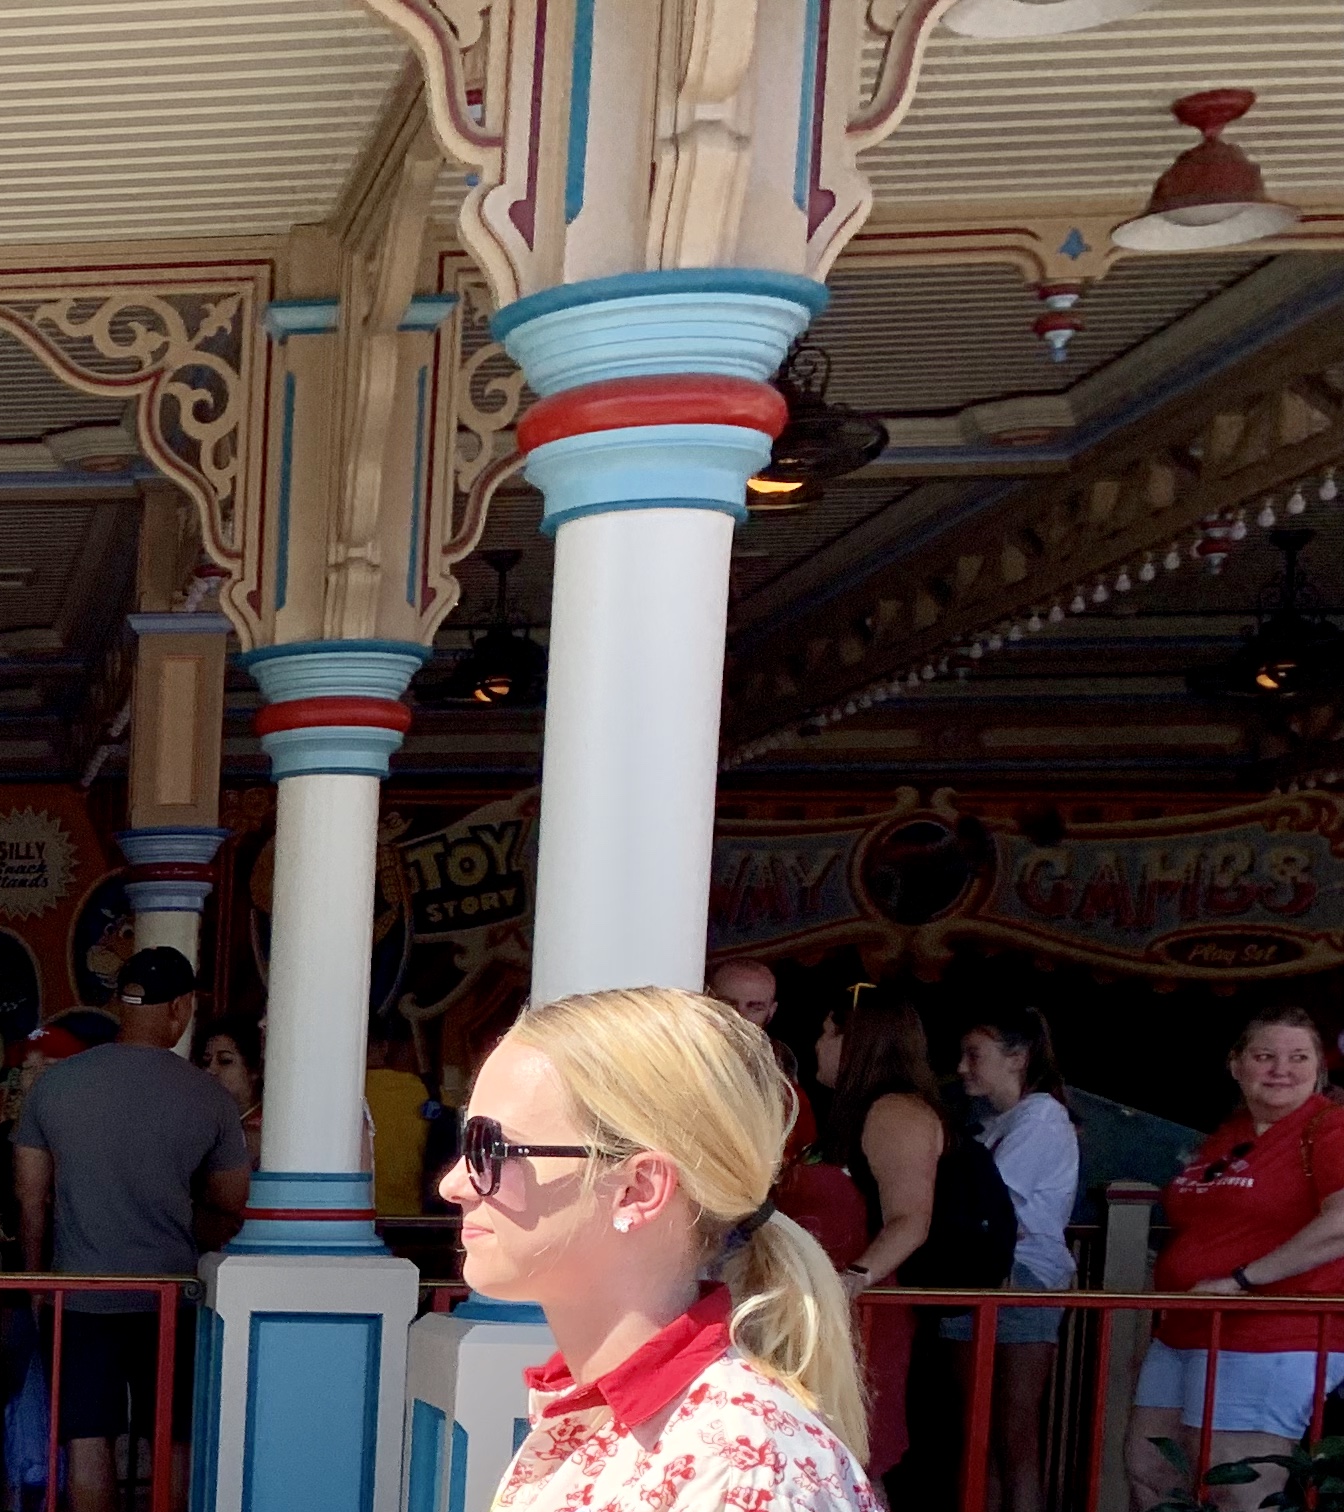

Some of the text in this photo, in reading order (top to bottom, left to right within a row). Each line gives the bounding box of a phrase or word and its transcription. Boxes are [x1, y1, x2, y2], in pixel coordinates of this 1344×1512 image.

[406, 823, 520, 891] TOY
[425, 888, 519, 923] STORY
[1015, 842, 1318, 933] GAMES
[1187, 942, 1280, 965] Play Set
